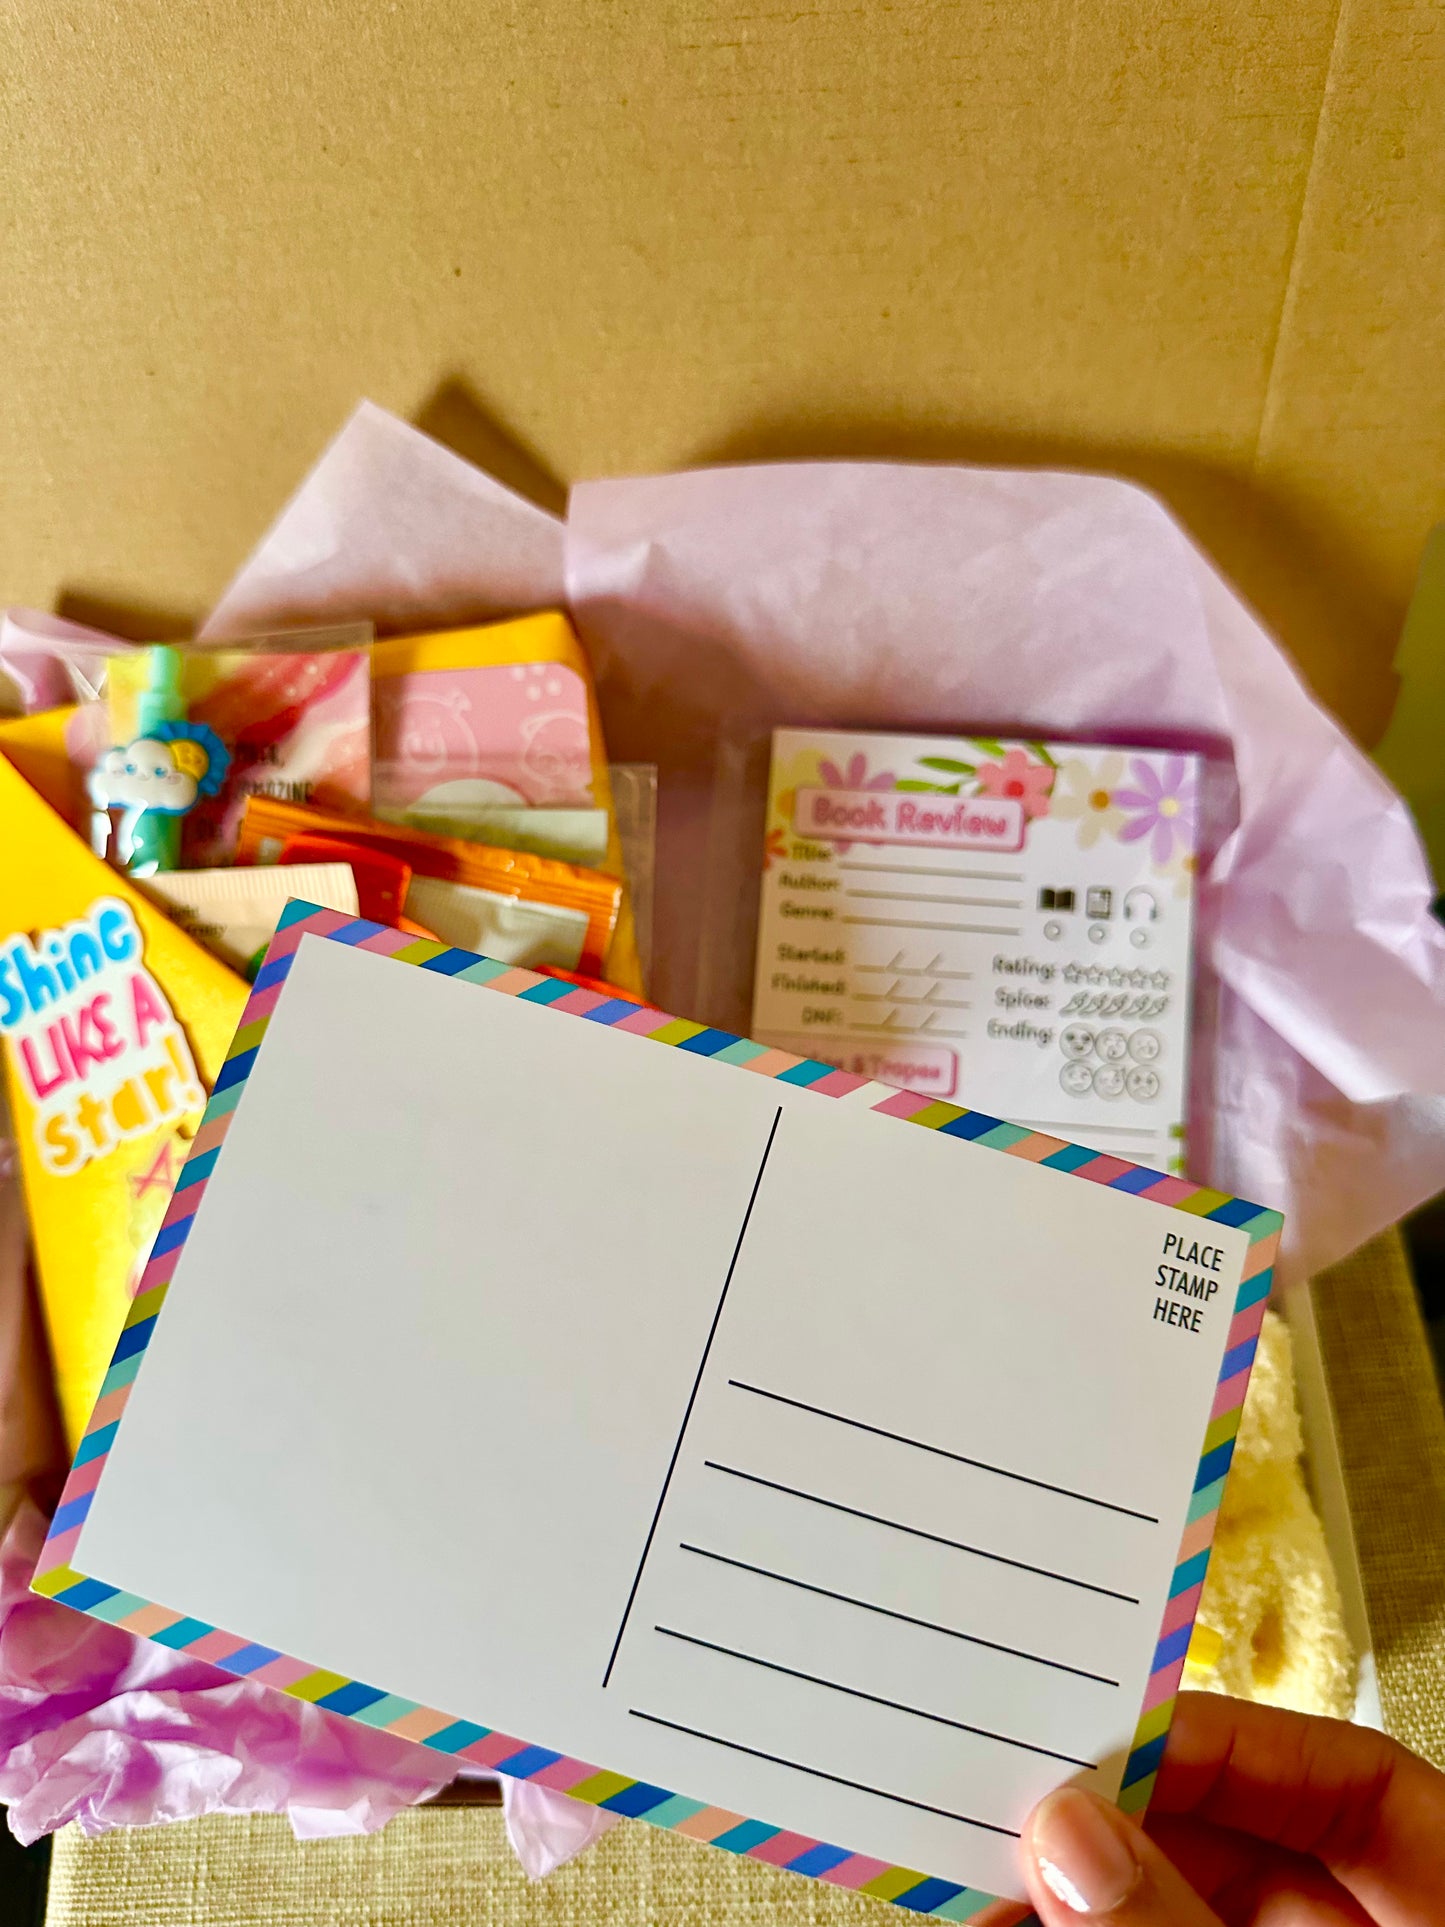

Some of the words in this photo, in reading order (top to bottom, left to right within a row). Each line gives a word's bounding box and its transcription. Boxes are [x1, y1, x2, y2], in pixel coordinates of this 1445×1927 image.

[814, 797, 886, 830] Book
[896, 802, 1007, 837] Review
[0, 909, 133, 1026] Shine
[993, 954, 1056, 984] Rating:
[994, 985, 1050, 1011] Spice:
[20, 992, 127, 1100] LIKE
[130, 972, 168, 1050] A
[987, 1017, 1053, 1048] Ending:
[1162, 1232, 1224, 1272] PLACE
[1155, 1264, 1219, 1301] STAMP
[1153, 1297, 1203, 1333] HERE
